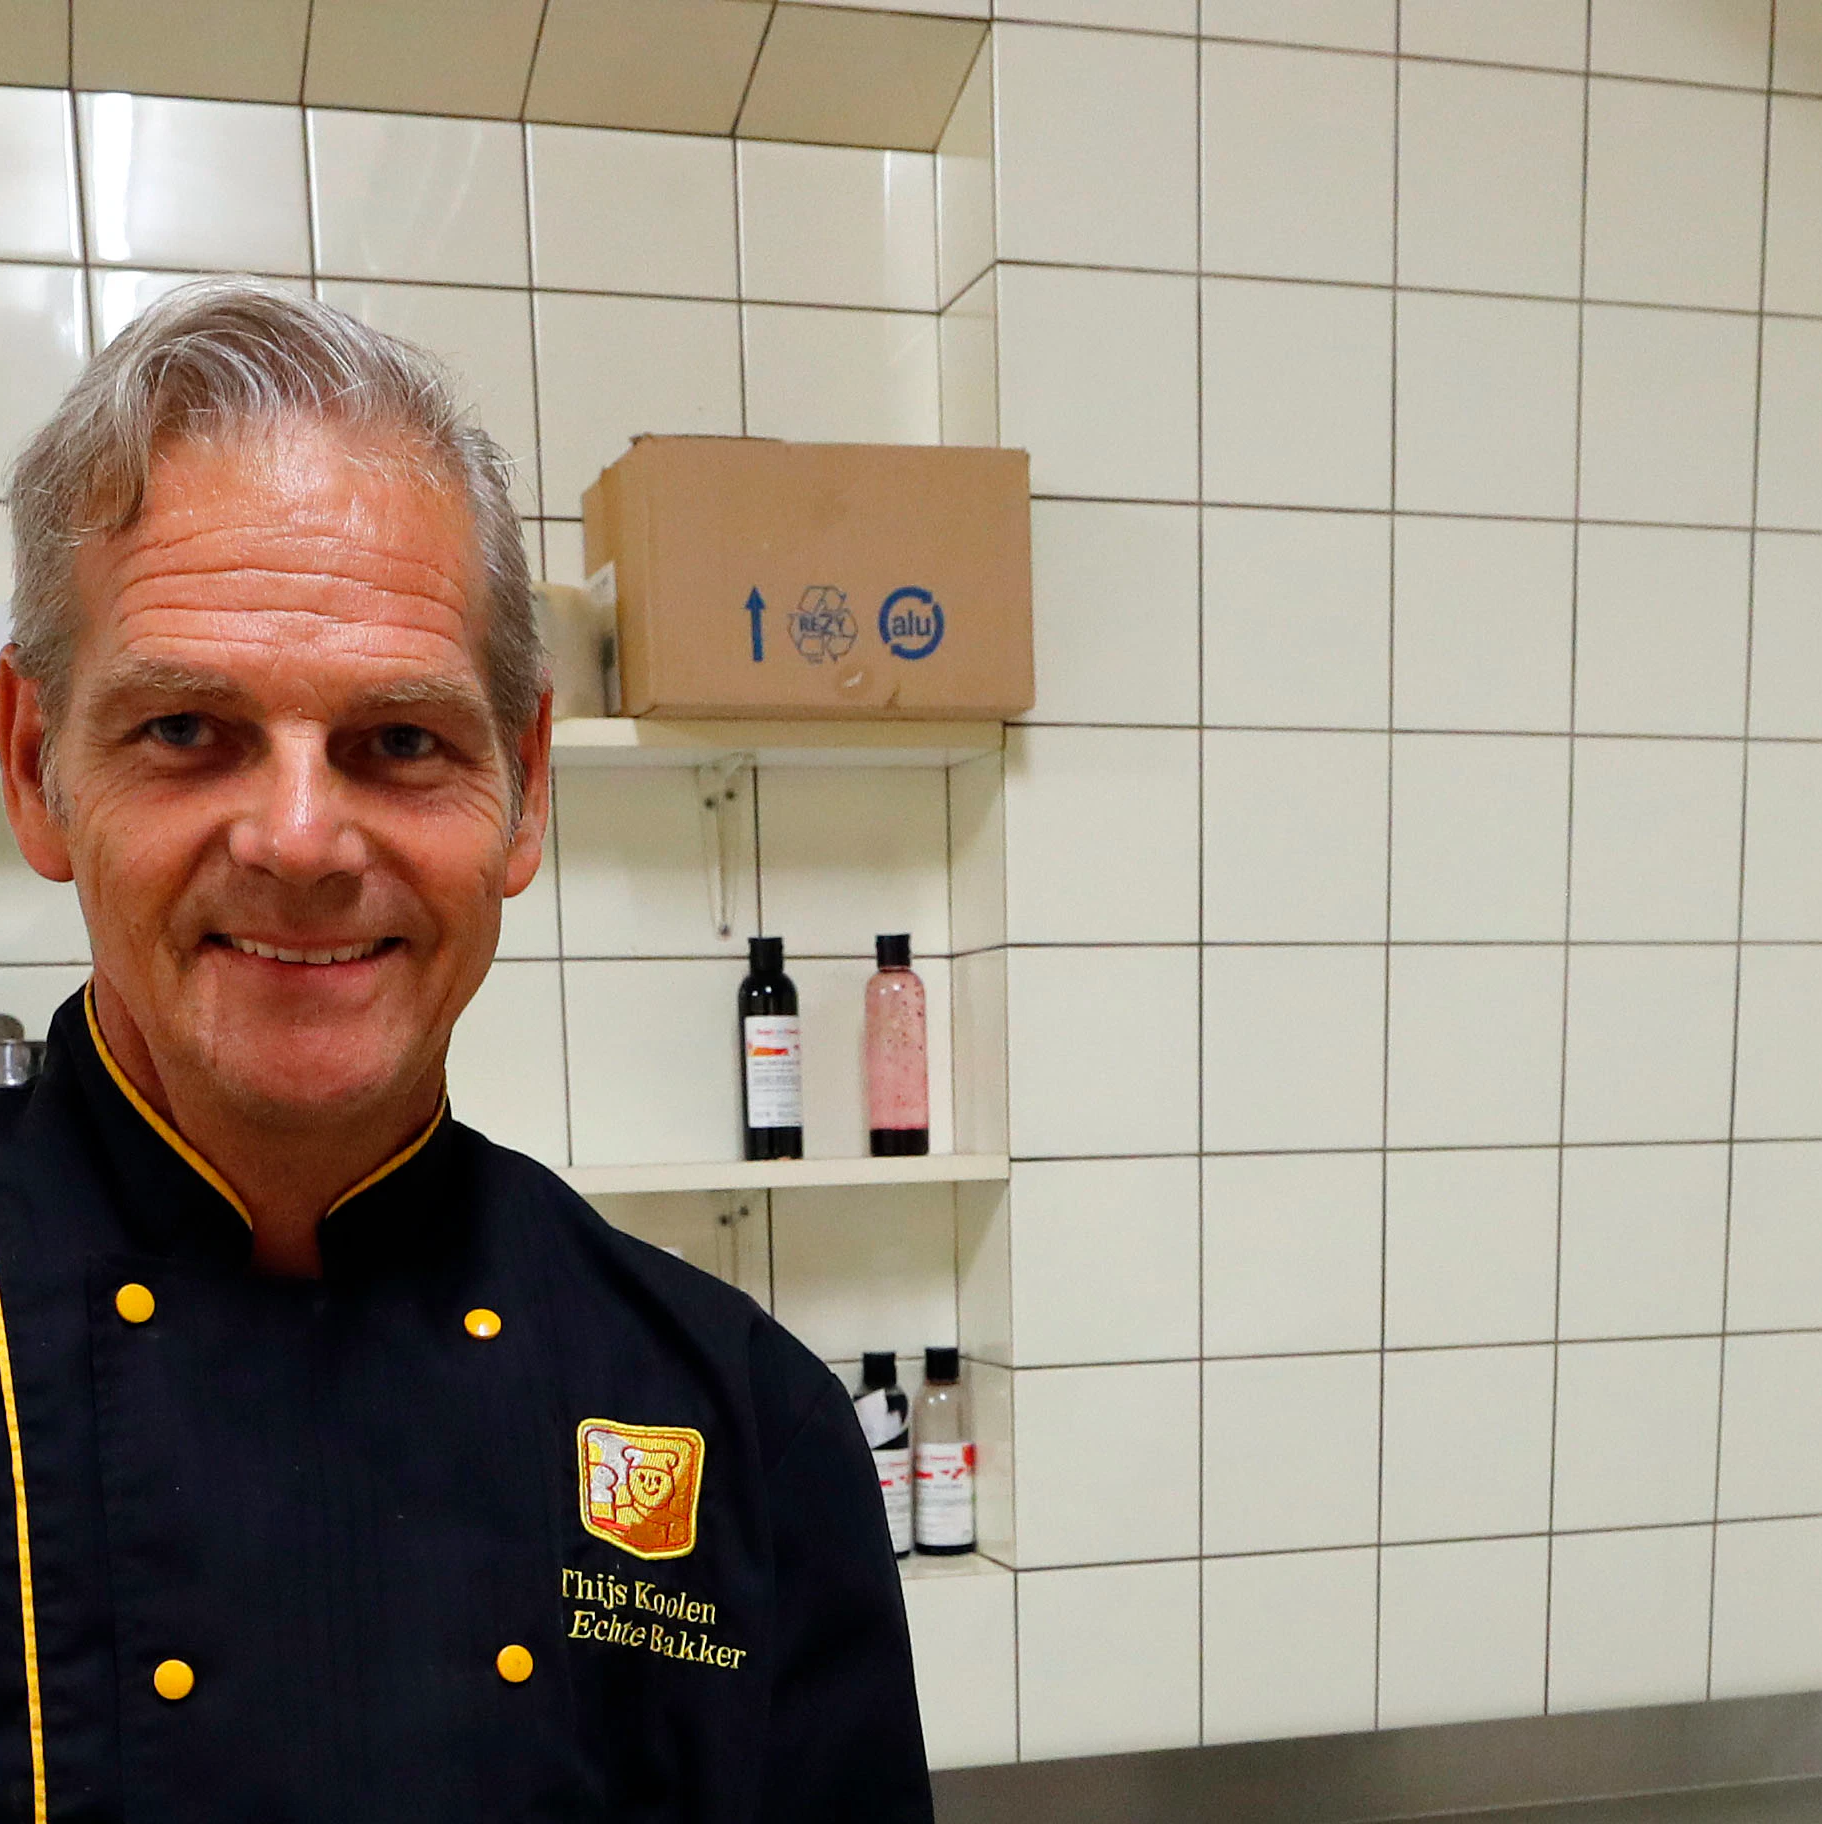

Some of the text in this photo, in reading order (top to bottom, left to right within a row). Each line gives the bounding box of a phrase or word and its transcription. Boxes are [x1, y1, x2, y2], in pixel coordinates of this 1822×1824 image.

[892, 610, 931, 637] alu
[634, 1580, 717, 1625] Koolen
[568, 1610, 746, 1669] Echte Bakker
